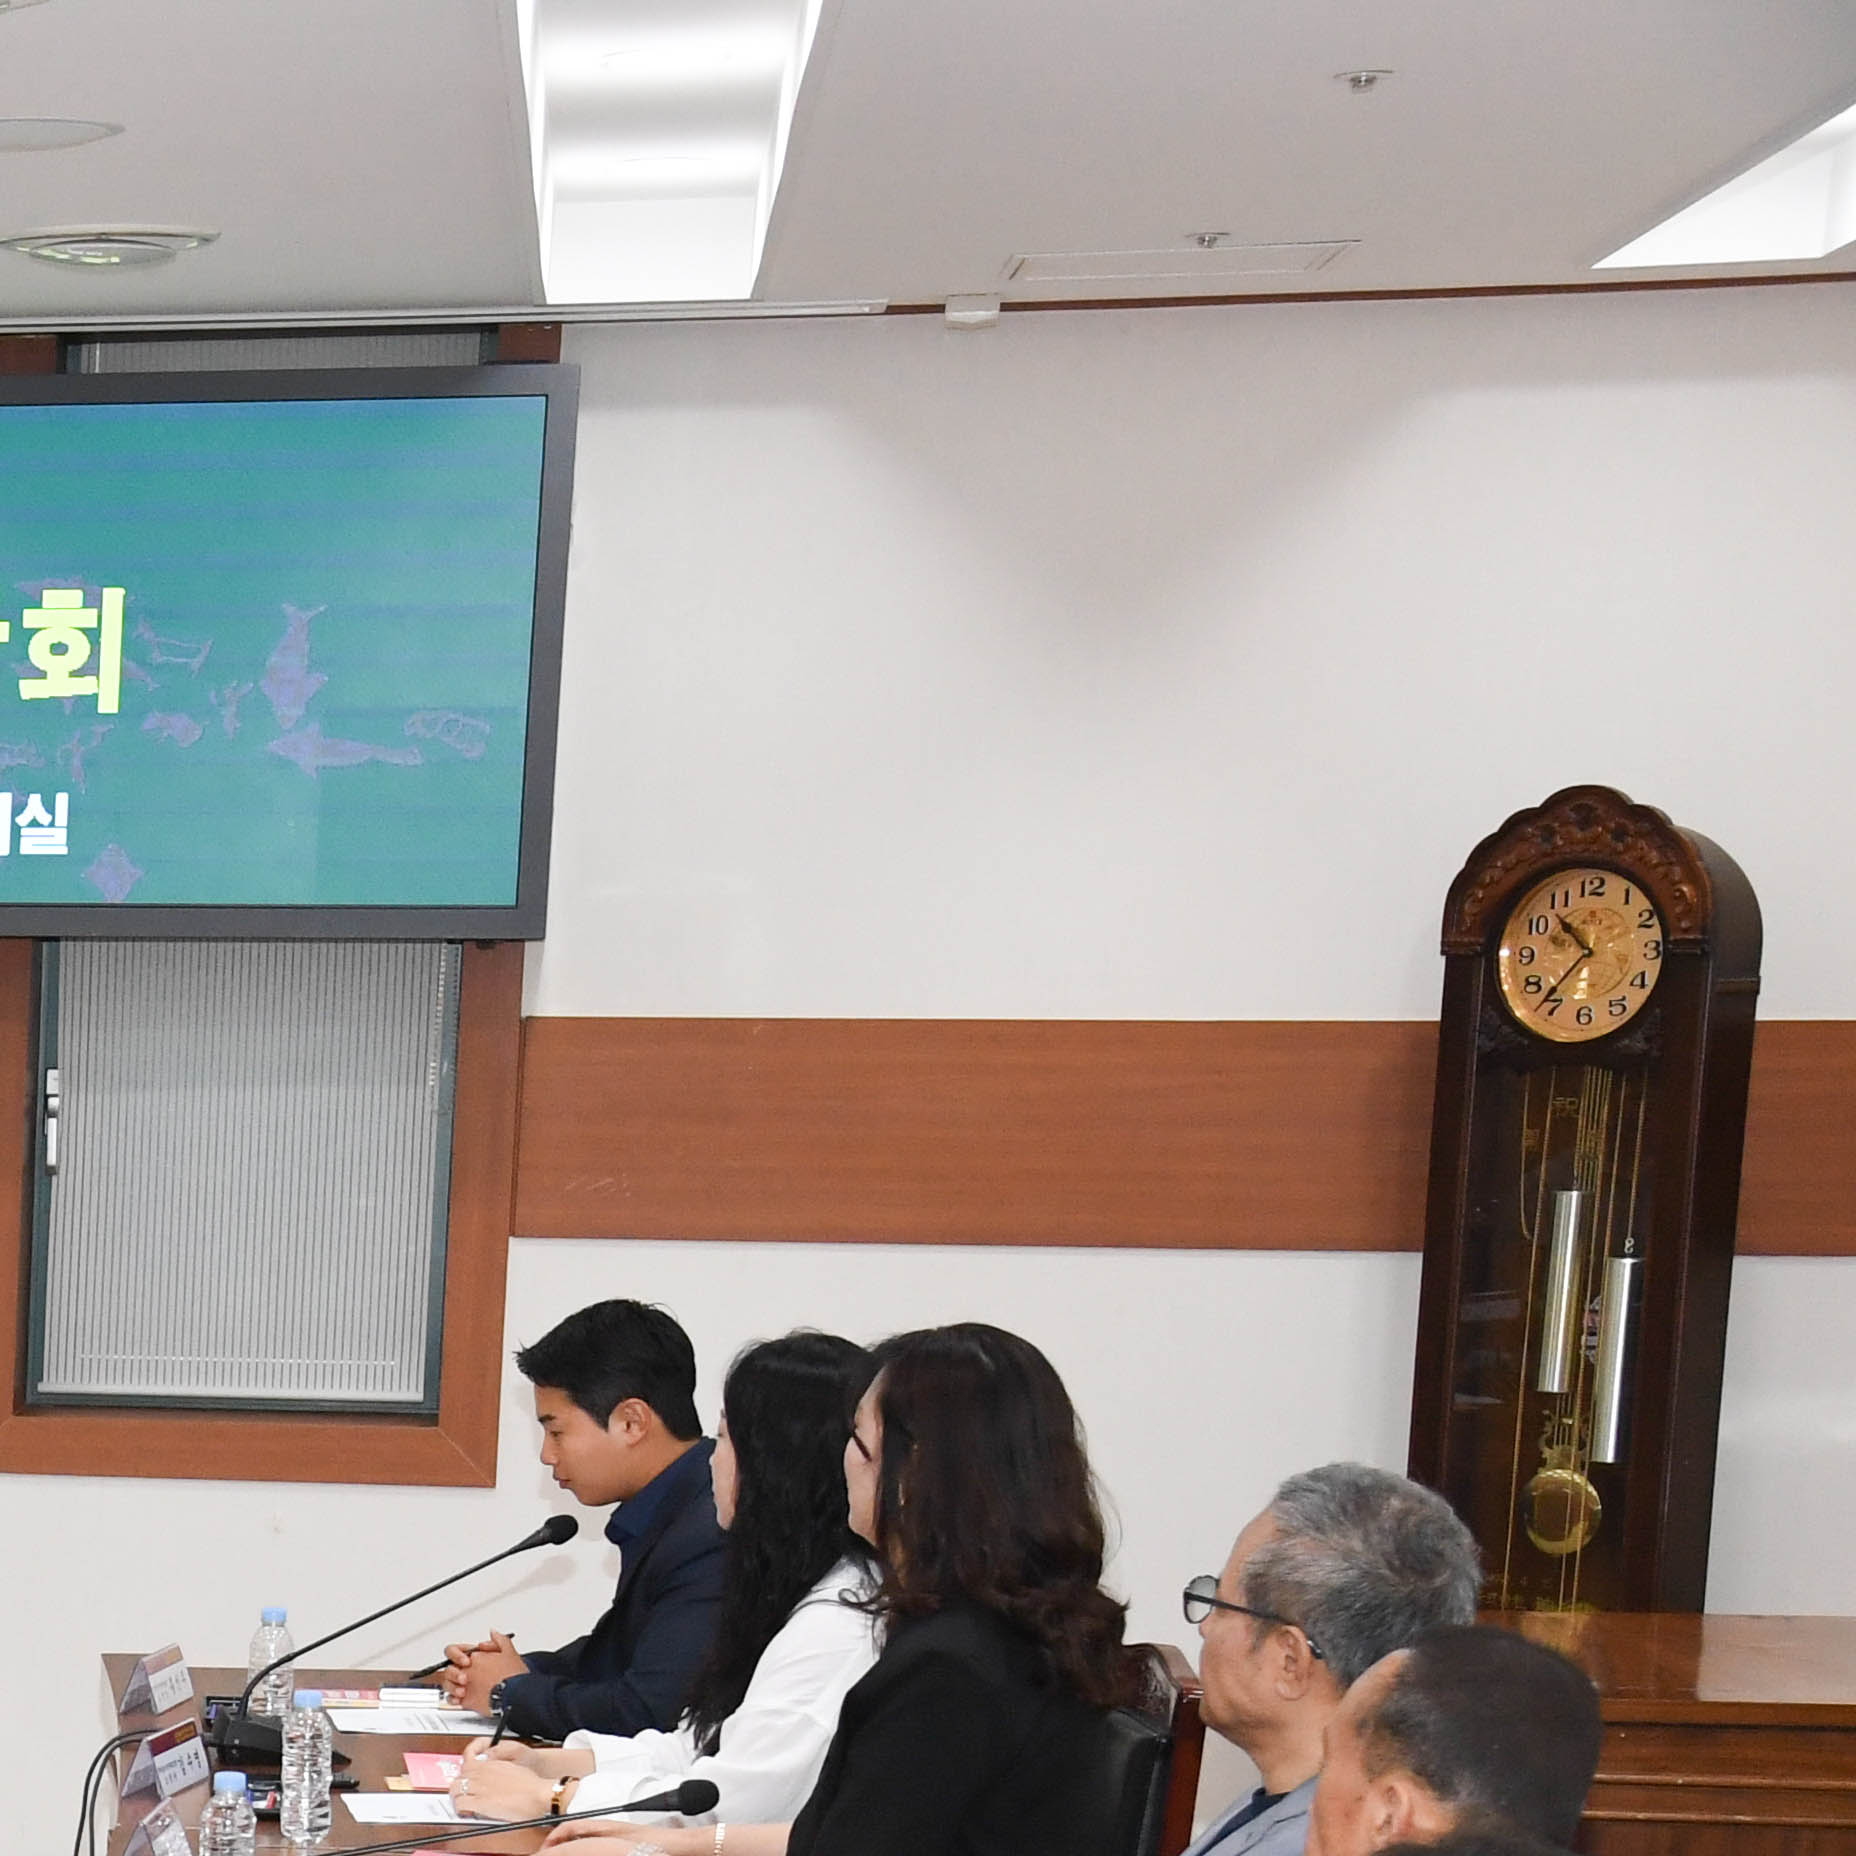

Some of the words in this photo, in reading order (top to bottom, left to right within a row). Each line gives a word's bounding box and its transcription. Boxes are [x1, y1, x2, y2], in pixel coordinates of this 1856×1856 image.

[1579, 876, 1606, 898] 12
[1623, 887, 1632, 906] 1
[1550, 889, 1571, 910] 11
[1528, 915, 1549, 936] 10
[1637, 909, 1655, 929] 2
[1518, 946, 1535, 966] 9
[1643, 940, 1661, 960] 3
[1524, 975, 1542, 994] 8
[1629, 970, 1648, 990] 4
[1544, 997, 1564, 1017] 7
[1576, 1006, 1593, 1026] 6
[1608, 995, 1628, 1017] 5
